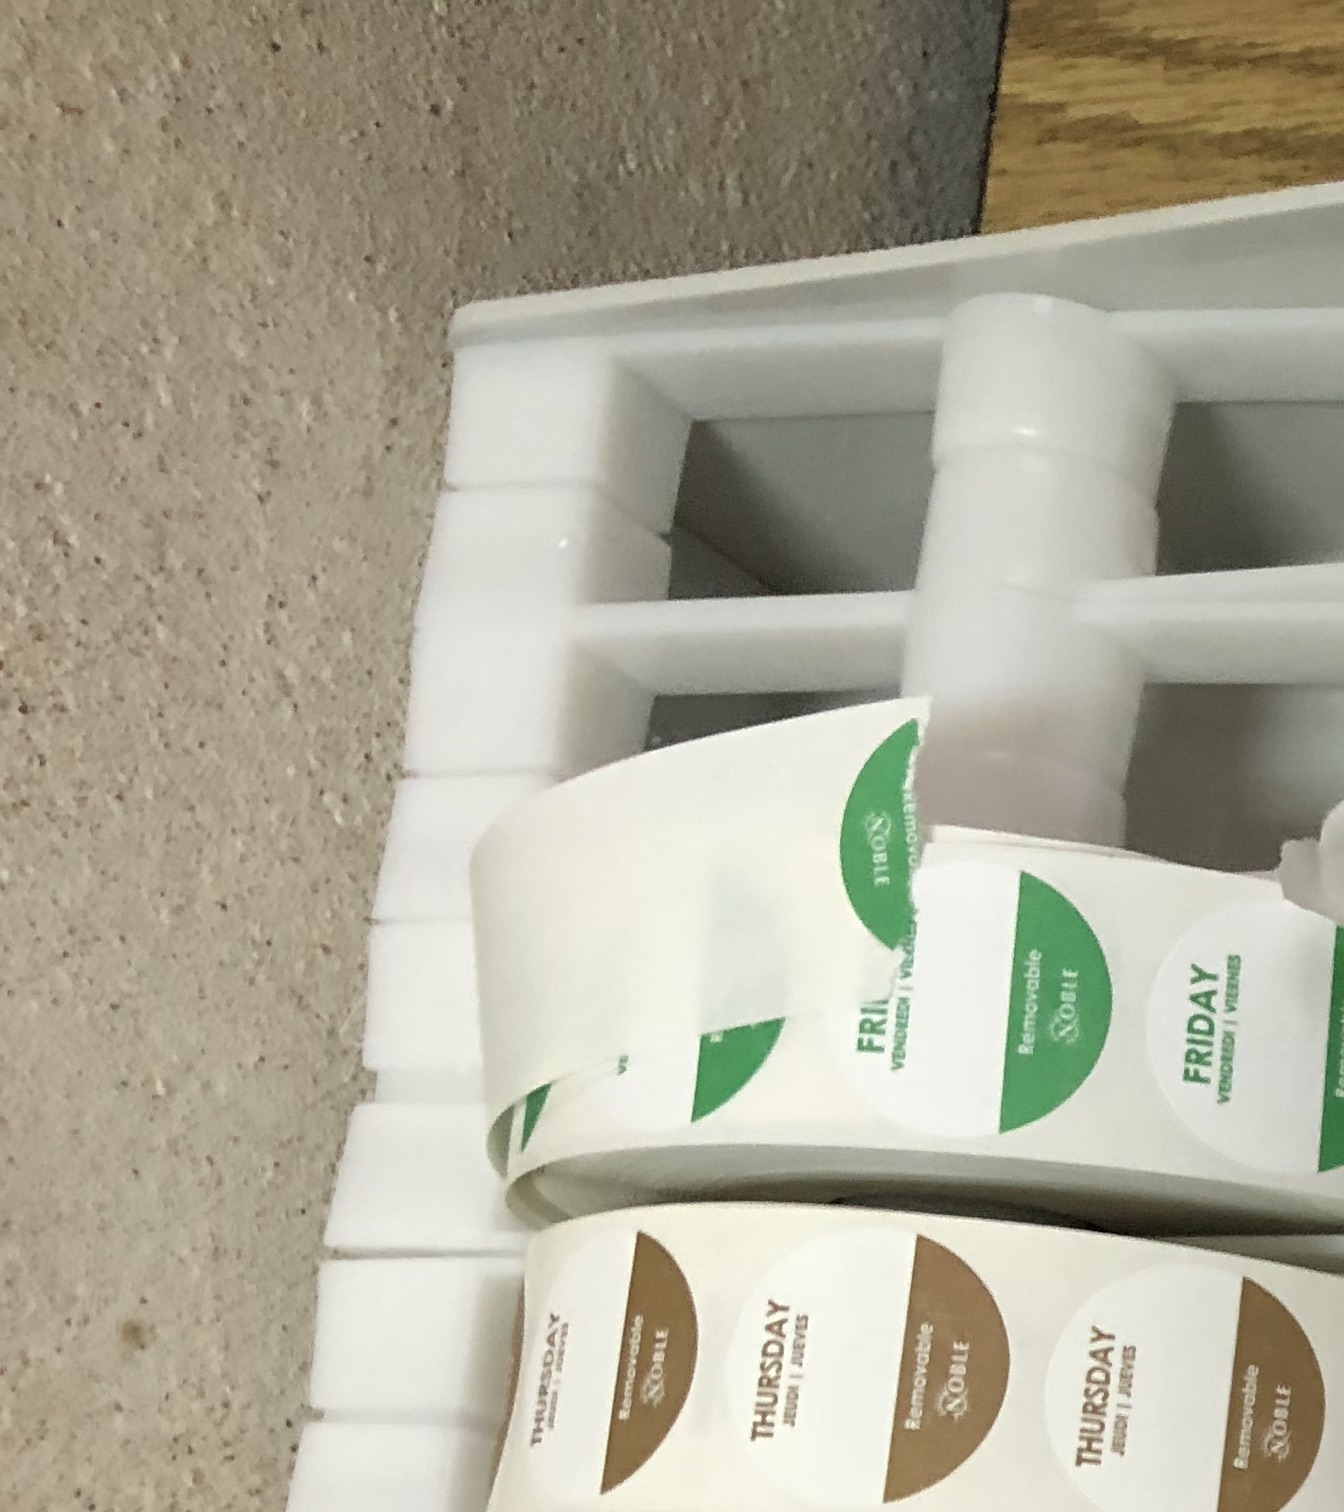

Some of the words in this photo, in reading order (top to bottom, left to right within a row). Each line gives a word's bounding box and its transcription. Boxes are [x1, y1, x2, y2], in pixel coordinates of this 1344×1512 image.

[864, 809, 893, 888] NOBLE
[857, 1000, 888, 1054] FRI
[891, 996, 910, 1072] VENDREDI
[1018, 948, 1043, 1055] Removable
[1050, 968, 1080, 1046] NOBLE
[1183, 963, 1219, 1085] FRIDAY
[1223, 954, 1241, 1014] VIERNES
[1217, 1031, 1236, 1105] VENDREDI
[530, 1312, 562, 1449] THURSDAY
[618, 1314, 644, 1421] Removable
[640, 1327, 668, 1406] NOBLE
[750, 1298, 790, 1443] THURSDAY
[782, 1385, 800, 1428] JEUDI
[791, 1313, 809, 1368] JUEVES
[904, 1321, 934, 1431] Removable
[937, 1340, 970, 1421] NOBLE
[1075, 1324, 1116, 1468] THURSDAY
[1110, 1411, 1127, 1457] JEUDI
[1119, 1344, 1137, 1401] JUEVES
[1233, 1362, 1260, 1472] Removable
[1263, 1382, 1293, 1465] NOBLE
